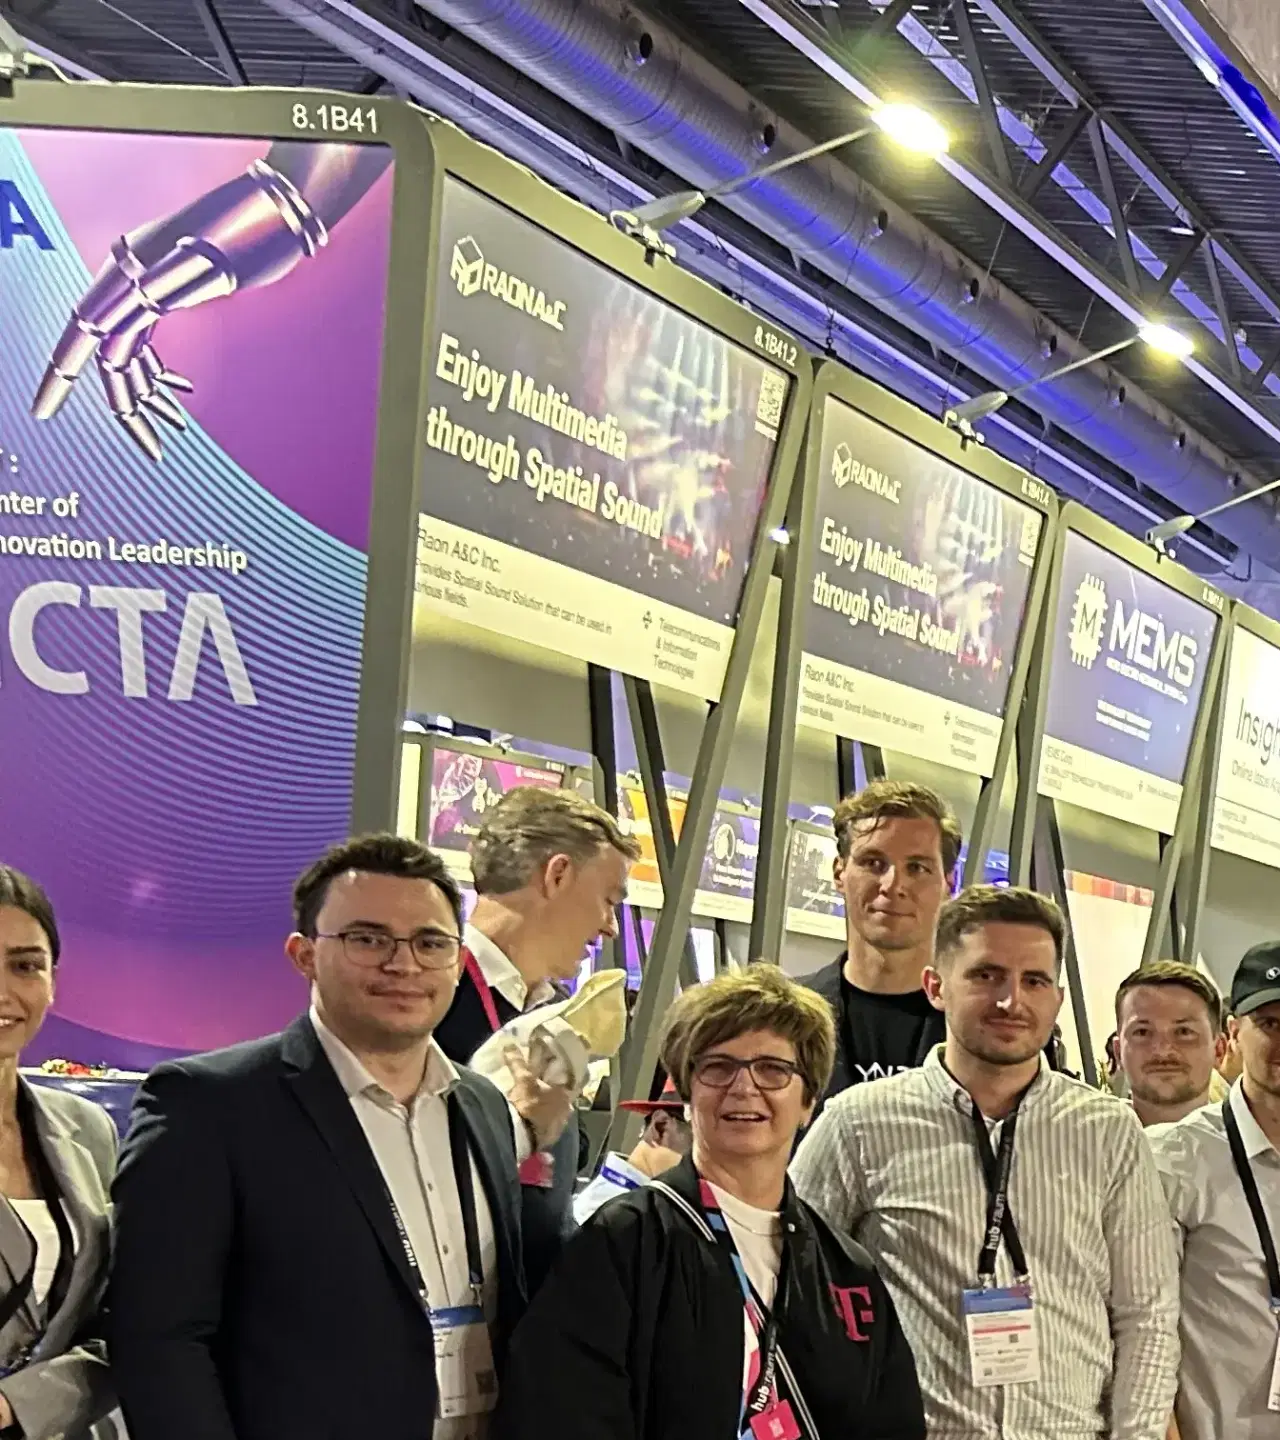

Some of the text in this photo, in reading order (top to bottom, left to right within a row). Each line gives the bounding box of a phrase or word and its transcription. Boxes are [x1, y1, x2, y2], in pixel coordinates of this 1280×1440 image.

[292, 104, 379, 133] 8.1B41
[436, 332, 628, 461] Enjoy Multimedia
[53, 492, 79, 517] of
[426, 406, 664, 539] through Spatial Sound
[109, 537, 248, 575] Leadership
[451, 540, 480, 566] A&C
[481, 549, 501, 574] Inc.
[820, 516, 938, 598] Enjoy Multimedia
[813, 572, 960, 656] through Spatial Sound
[1109, 600, 1198, 688] MEMS
